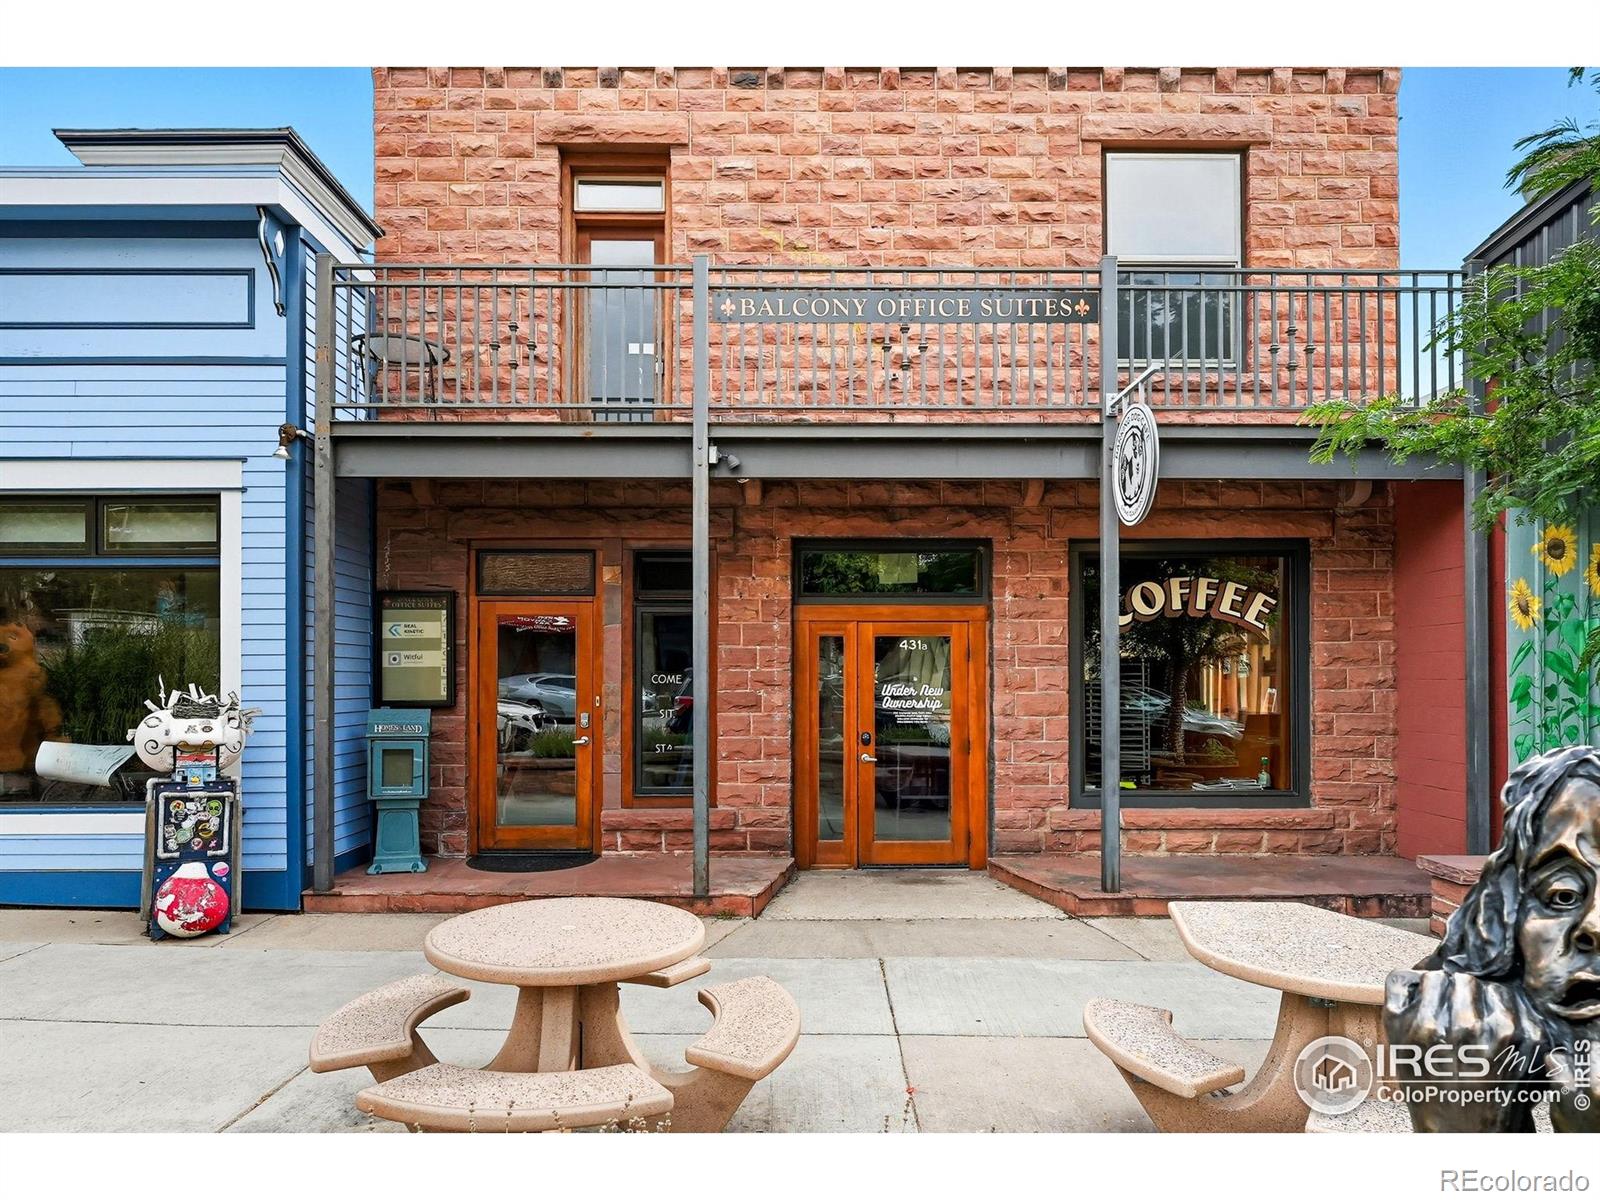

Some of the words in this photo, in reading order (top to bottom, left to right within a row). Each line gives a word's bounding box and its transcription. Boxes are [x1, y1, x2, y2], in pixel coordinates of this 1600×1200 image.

[740, 298, 868, 317] BALCONY
[877, 298, 972, 317] OFFICE
[981, 298, 1073, 317] SUITES
[899, 639, 928, 650] 431a
[651, 674, 683, 684] COME
[881, 683, 918, 696] Under
[919, 684, 944, 696] New
[882, 696, 943, 711] Ownership
